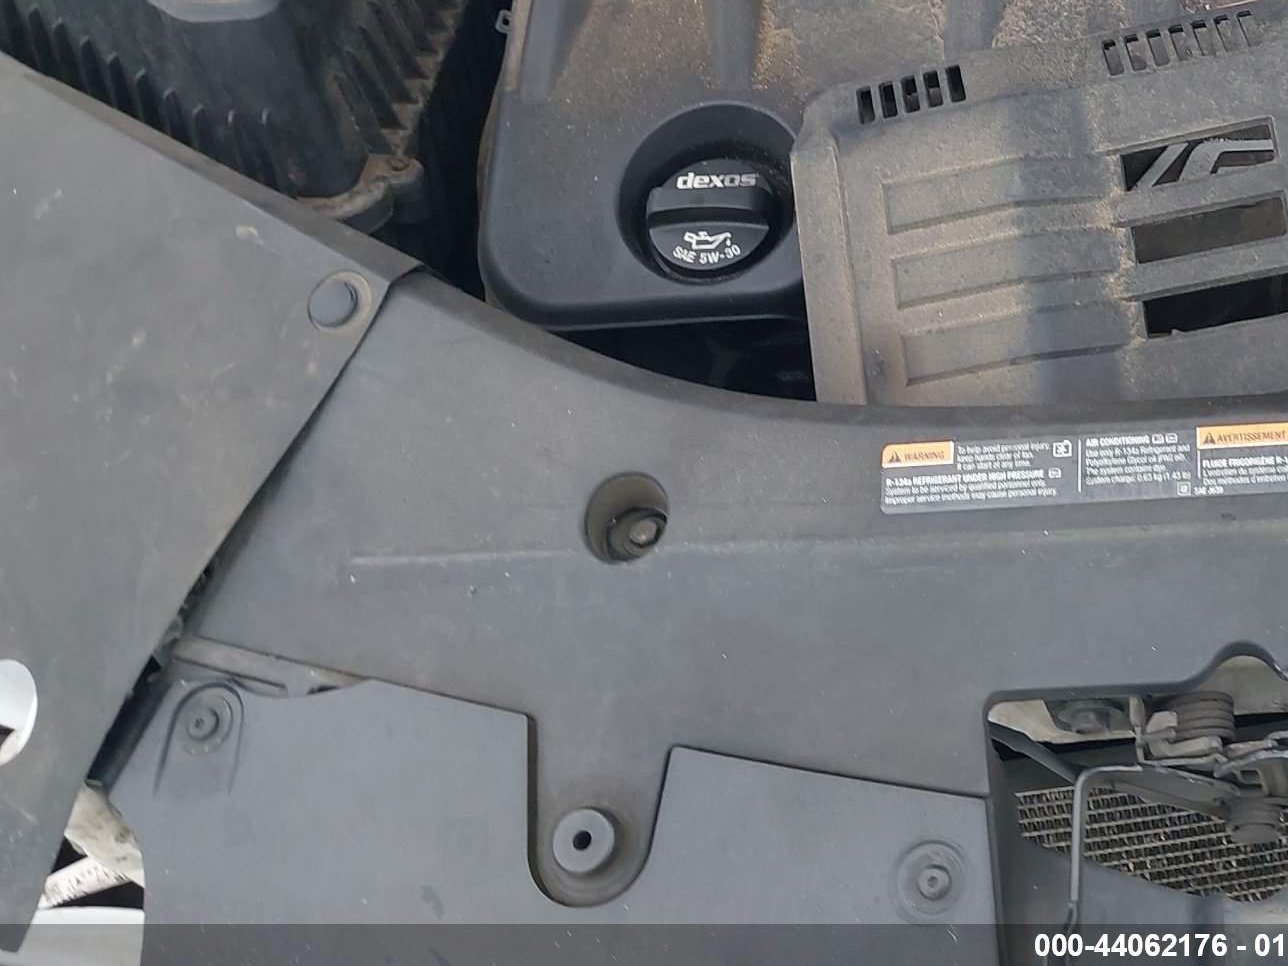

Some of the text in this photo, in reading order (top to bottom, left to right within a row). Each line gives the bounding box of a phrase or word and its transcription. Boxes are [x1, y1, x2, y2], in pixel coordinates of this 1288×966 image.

[676, 172, 758, 189] dexos
[673, 245, 741, 264] SAE 5W-30
[1086, 435, 1150, 447] AIR CONDITIONING
[1217, 430, 1286, 442] AVERTISSEMENT
[905, 450, 945, 461] WARNING
[962, 472, 988, 483] UNDER
[988, 471, 1006, 481] HIGH
[1007, 469, 1045, 480] PRESSURE
